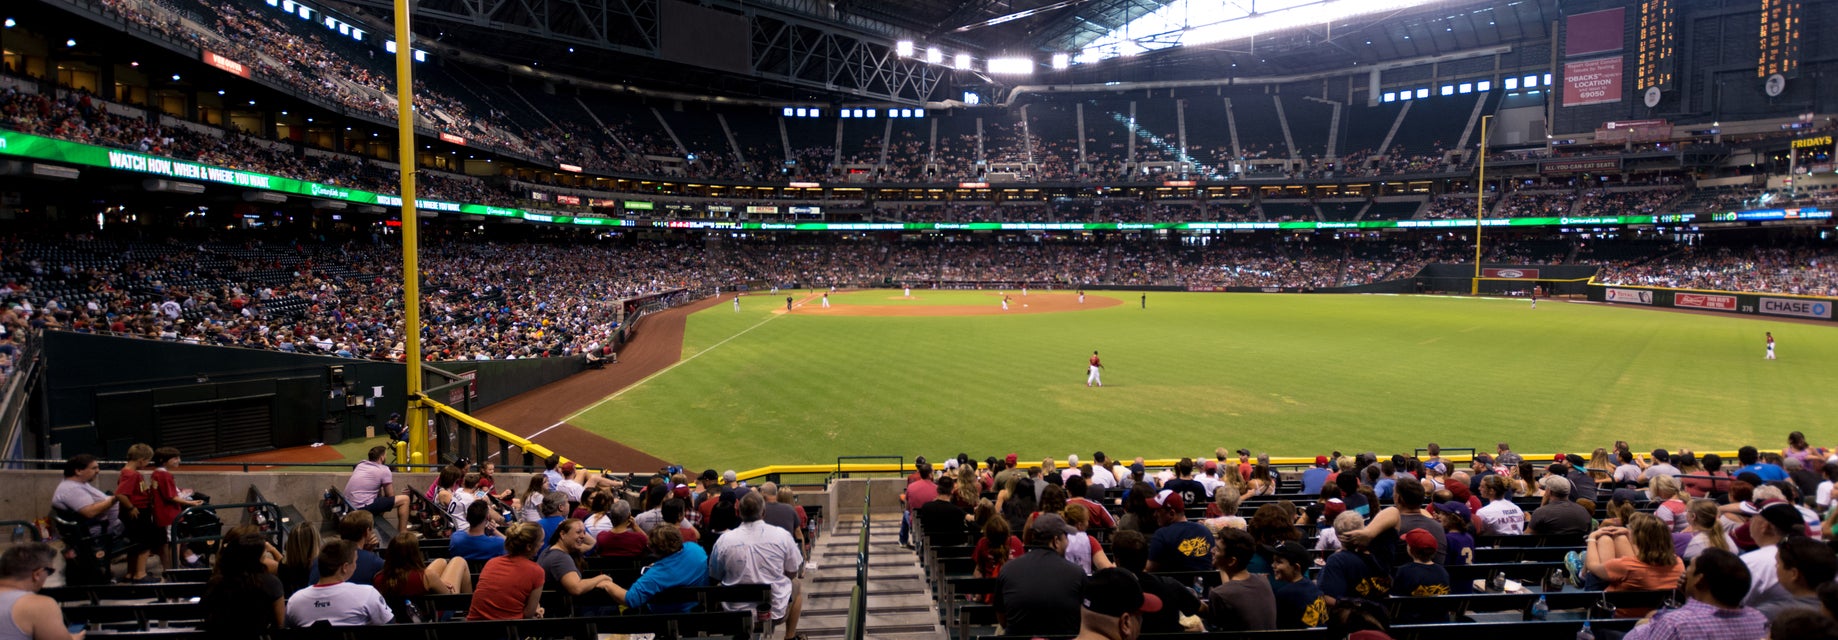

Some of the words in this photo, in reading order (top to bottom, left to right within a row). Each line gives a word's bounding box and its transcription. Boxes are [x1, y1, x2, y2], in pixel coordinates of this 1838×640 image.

[1574, 78, 1612, 89] LOCATION
[1580, 90, 1605, 99] 69050
[108, 151, 146, 171] WATCH
[147, 157, 173, 177] HOW,
[173, 162, 200, 179] WHEN
[200, 166, 208, 180] &
[208, 167, 235, 183] WHERE
[235, 172, 249, 186] YOU
[1765, 301, 1810, 313] CHASE
